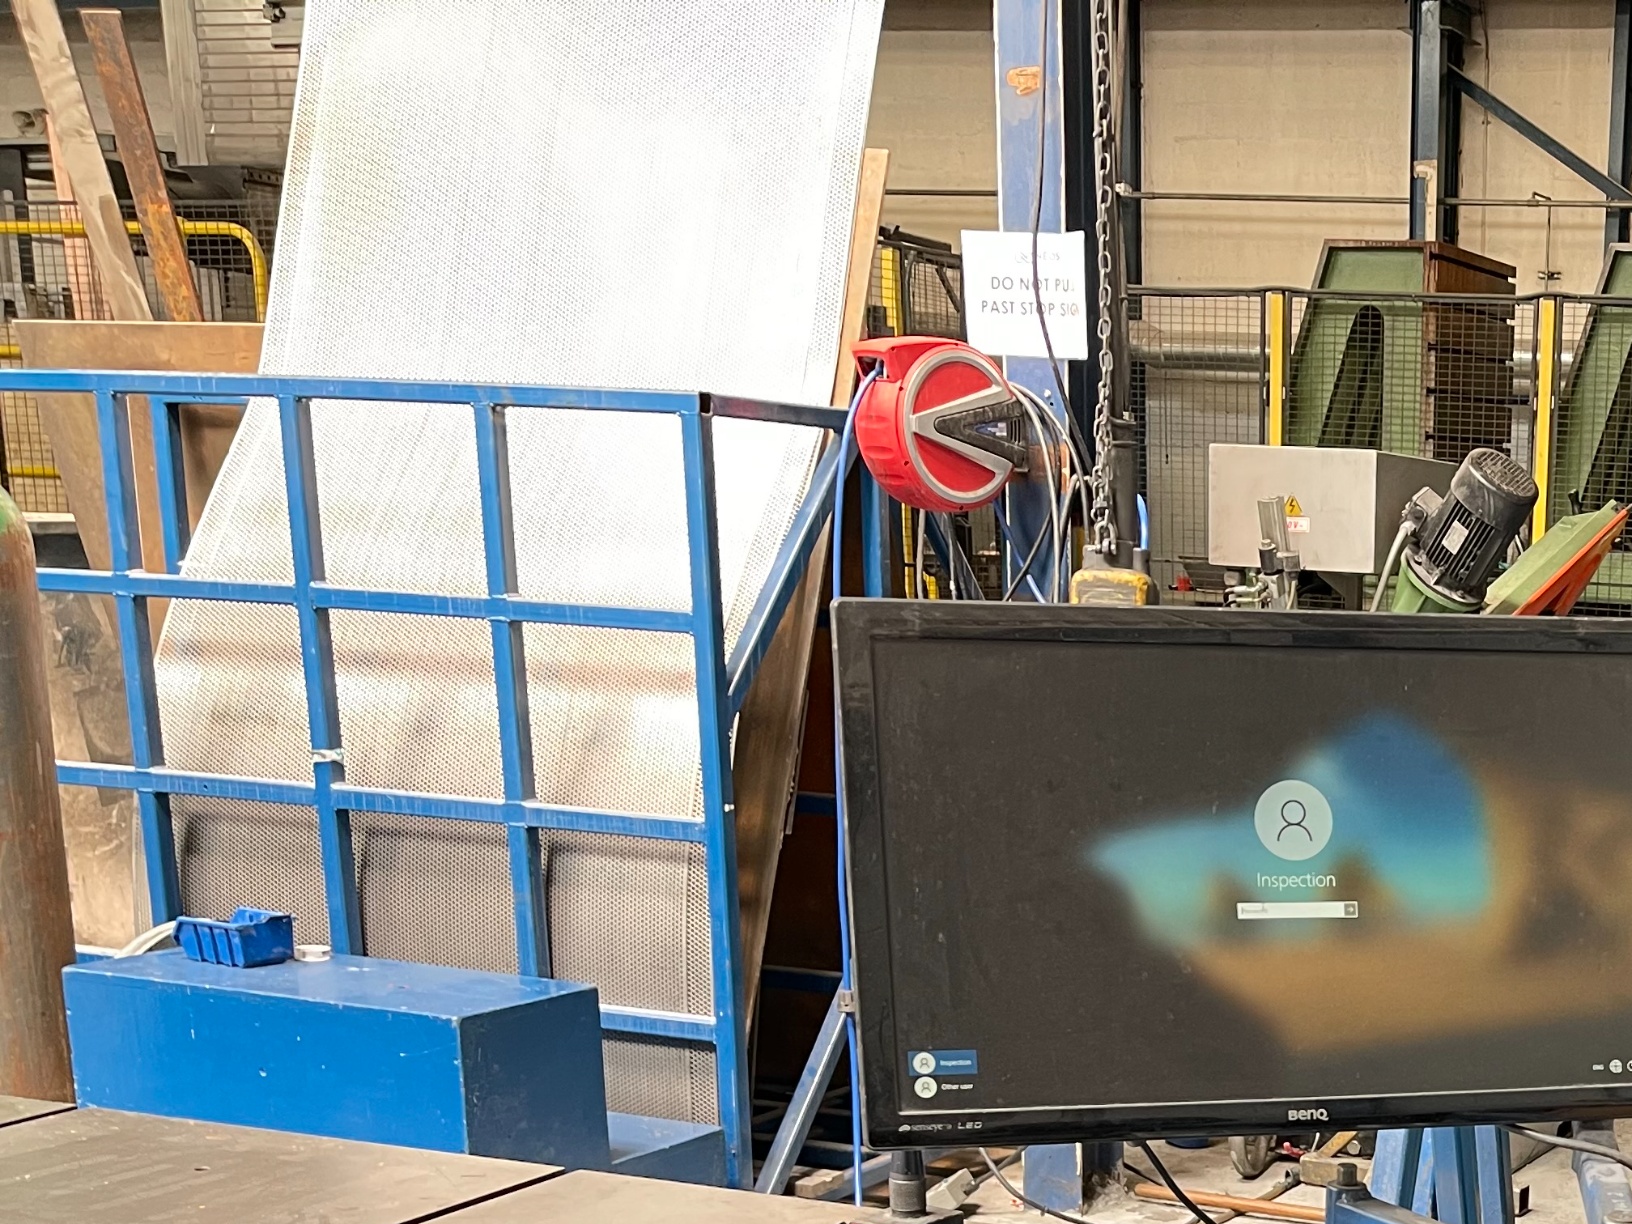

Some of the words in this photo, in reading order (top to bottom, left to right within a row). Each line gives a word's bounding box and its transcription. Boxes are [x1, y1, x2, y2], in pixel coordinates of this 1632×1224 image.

[990, 276, 1014, 290] DO
[1019, 276, 1050, 292] NOT
[981, 299, 1015, 315] PAST
[1020, 301, 1056, 316] STOP
[1256, 872, 1336, 891] Inspection
[1287, 1108, 1329, 1122] BenQ
[957, 1121, 983, 1130] LED
